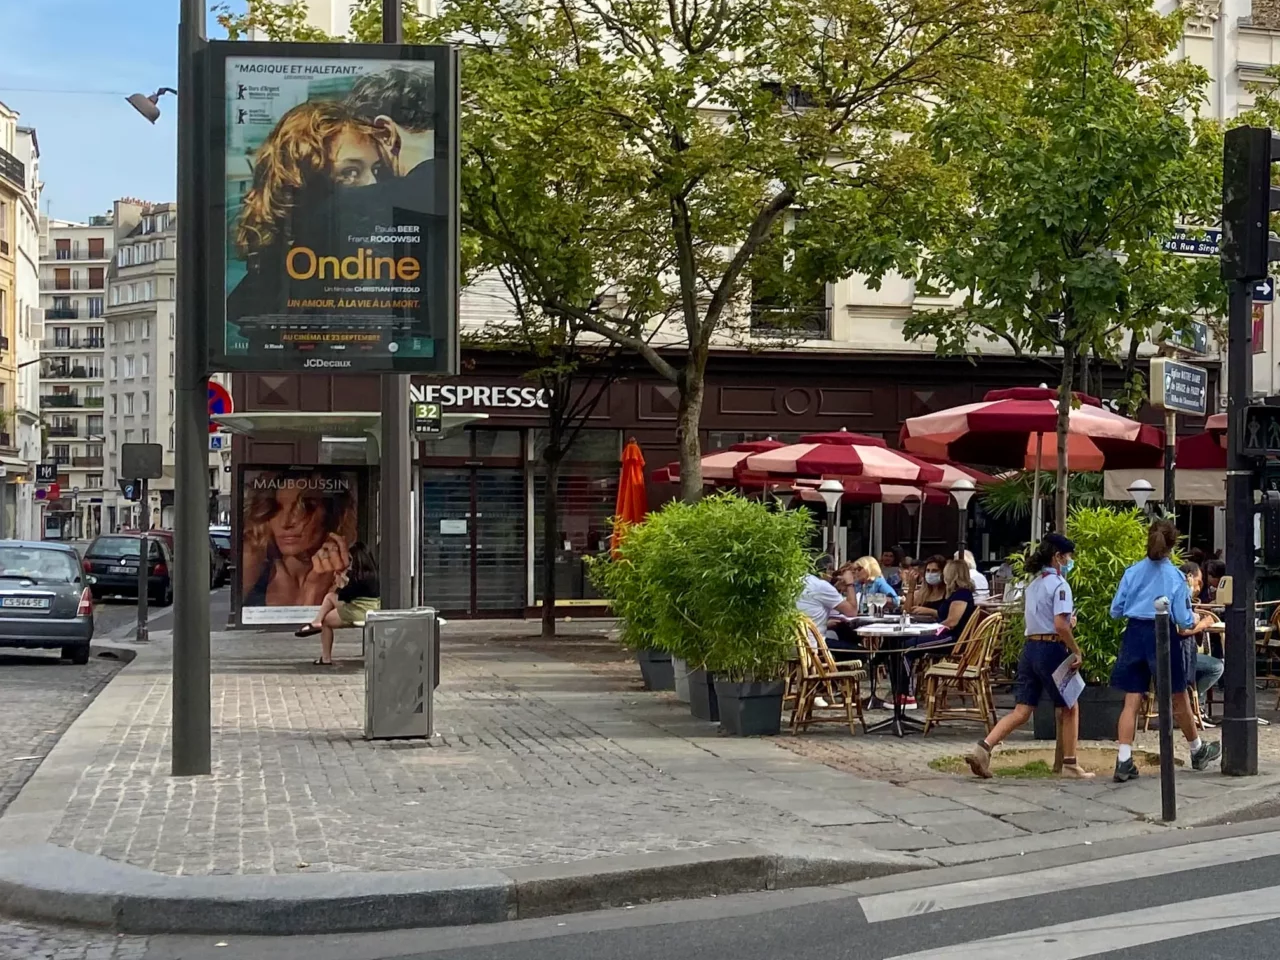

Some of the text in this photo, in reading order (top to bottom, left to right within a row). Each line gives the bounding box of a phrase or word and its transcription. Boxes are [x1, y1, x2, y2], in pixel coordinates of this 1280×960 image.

[290, 65, 304, 74] ET
[374, 225, 420, 233] Paula BEER
[347, 235, 421, 244] Franz ROGOWSKI
[1180, 242, 1195, 251] Rue
[1198, 243, 1220, 254] Singe
[286, 246, 421, 281] Ondine
[287, 299, 300, 308] UN
[301, 299, 336, 309] AMOUR,
[345, 299, 357, 308] LA
[358, 299, 373, 308] VIE
[380, 299, 392, 308] LA
[392, 299, 421, 309] MORT.
[303, 358, 352, 368] JCDecaux
[418, 405, 437, 418] 32
[253, 479, 349, 489] MAUBOUSSIN
